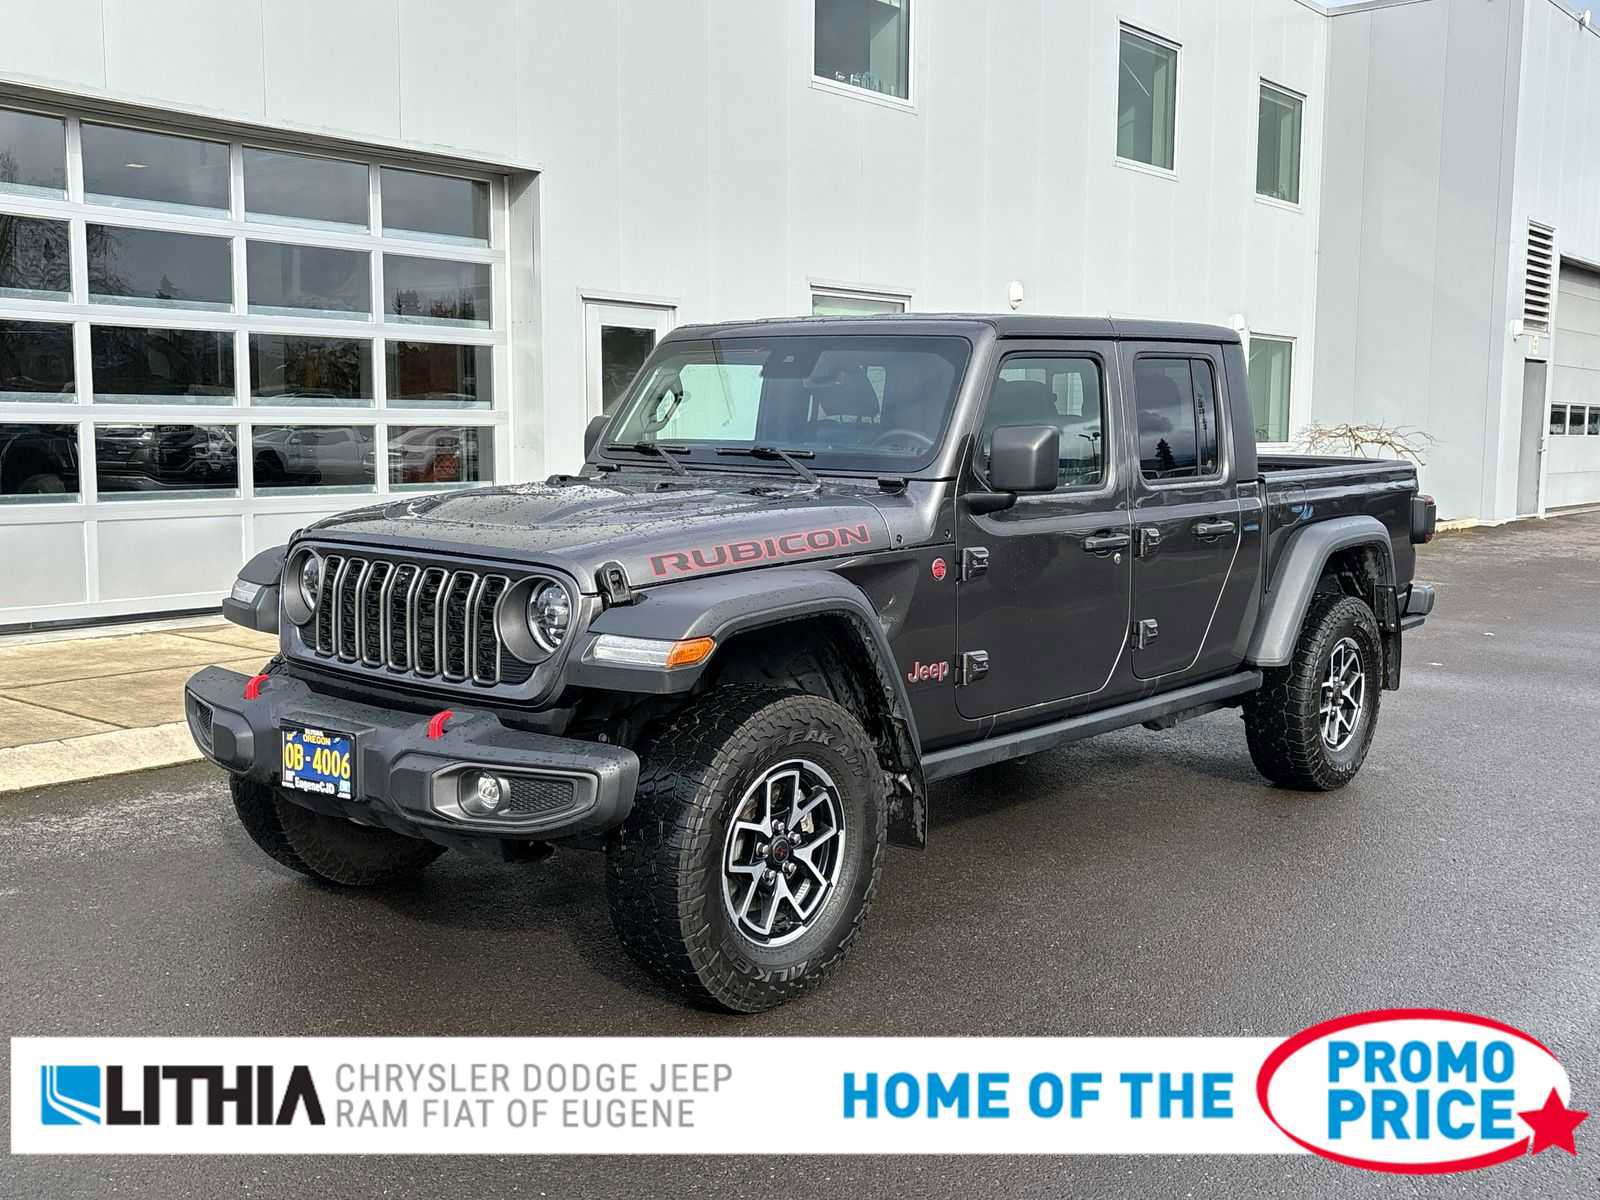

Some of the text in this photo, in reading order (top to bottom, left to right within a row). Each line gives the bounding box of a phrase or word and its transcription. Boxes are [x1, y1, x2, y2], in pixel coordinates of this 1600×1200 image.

[650, 522, 871, 577] RUBICON
[907, 661, 949, 683] Jeep
[303, 734, 331, 746] OREGON
